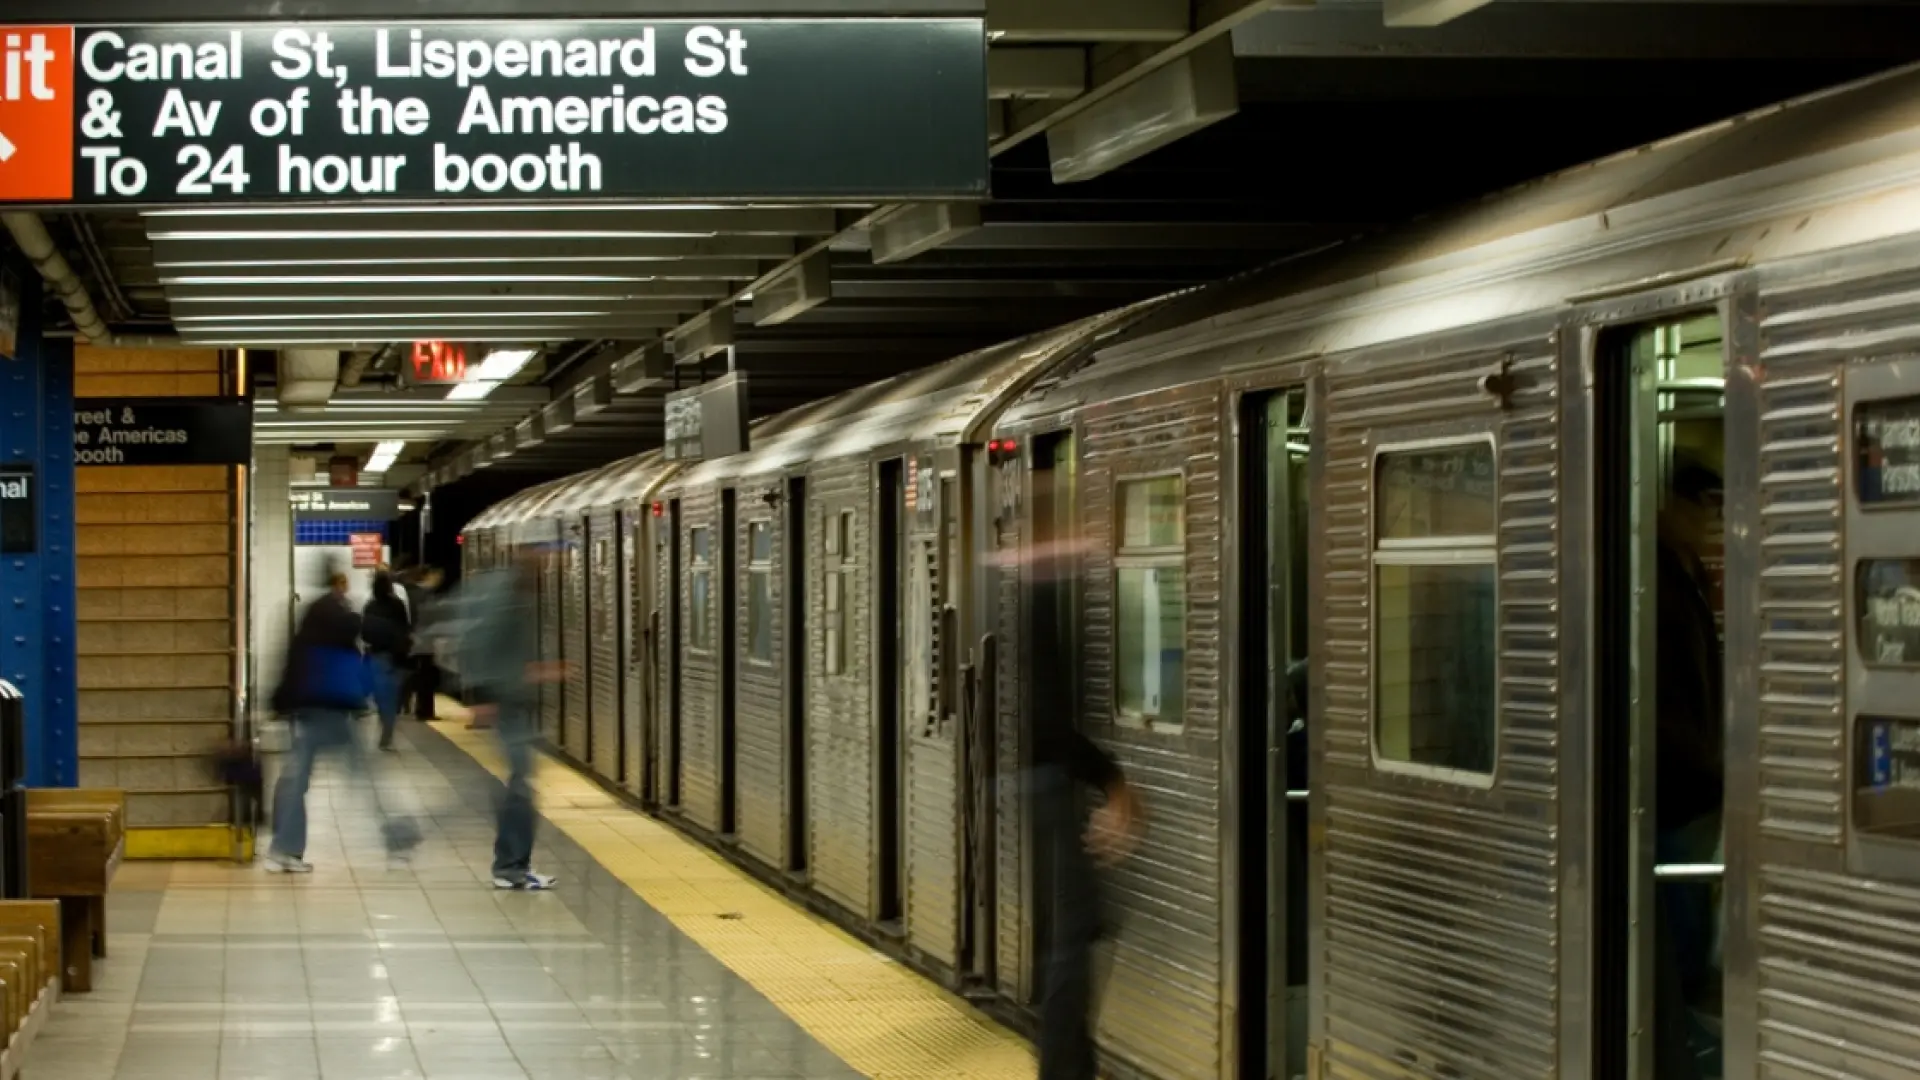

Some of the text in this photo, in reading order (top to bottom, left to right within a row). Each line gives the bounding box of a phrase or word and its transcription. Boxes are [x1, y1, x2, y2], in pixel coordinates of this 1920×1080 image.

[0, 34, 55, 101] it
[82, 27, 748, 88] Canal St, Lispenard St
[81, 84, 729, 138] & Av of the Americas
[81, 142, 602, 195] To 24 hour booth
[99, 426, 188, 444] Americas
[121, 406, 135, 424] &
